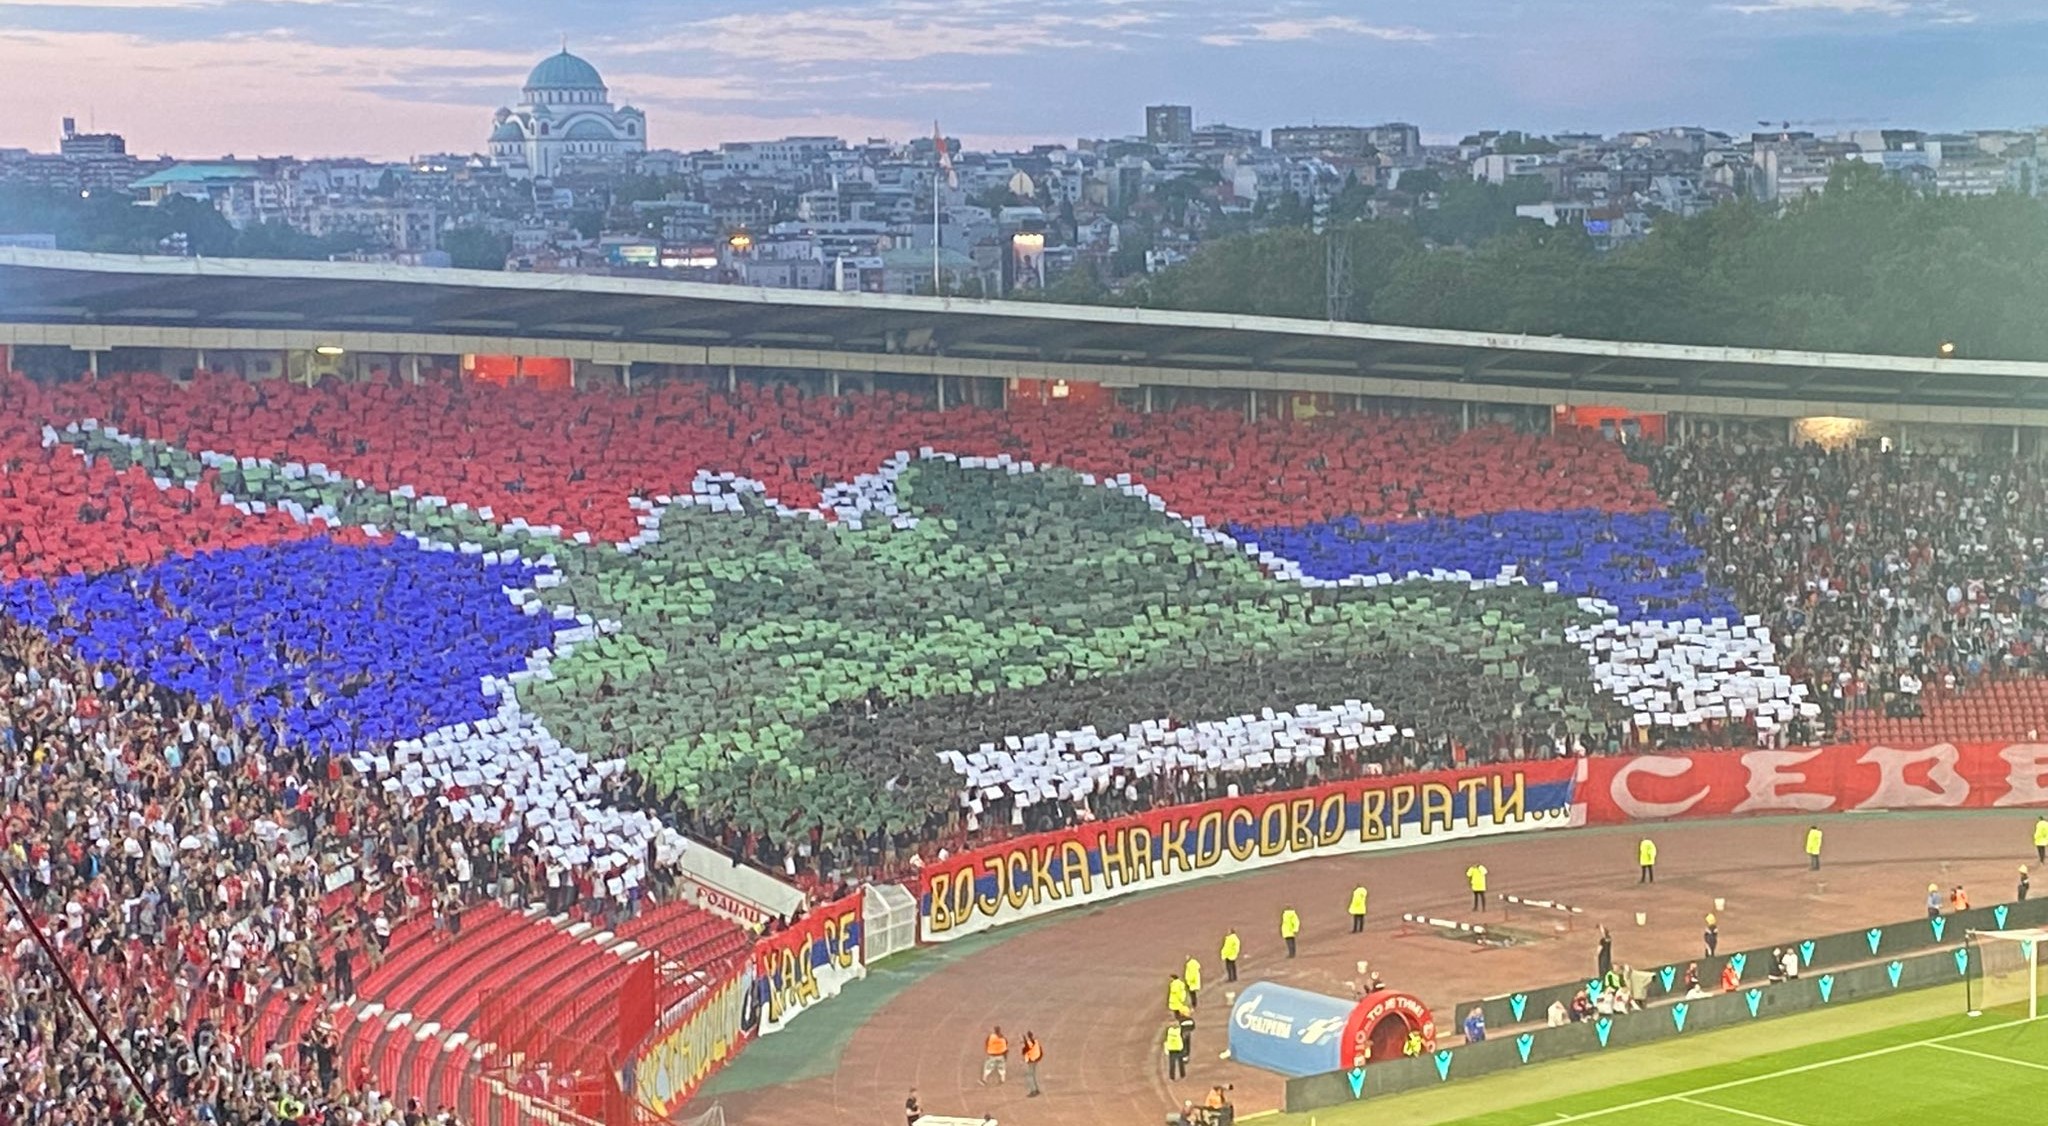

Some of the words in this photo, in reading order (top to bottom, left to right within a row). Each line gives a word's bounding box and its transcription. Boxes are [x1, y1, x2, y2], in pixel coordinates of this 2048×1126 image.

[930, 840, 1093, 934] ВОЈСКА
[1099, 825, 1155, 890] НА
[1160, 792, 1347, 877] КОСОВО
